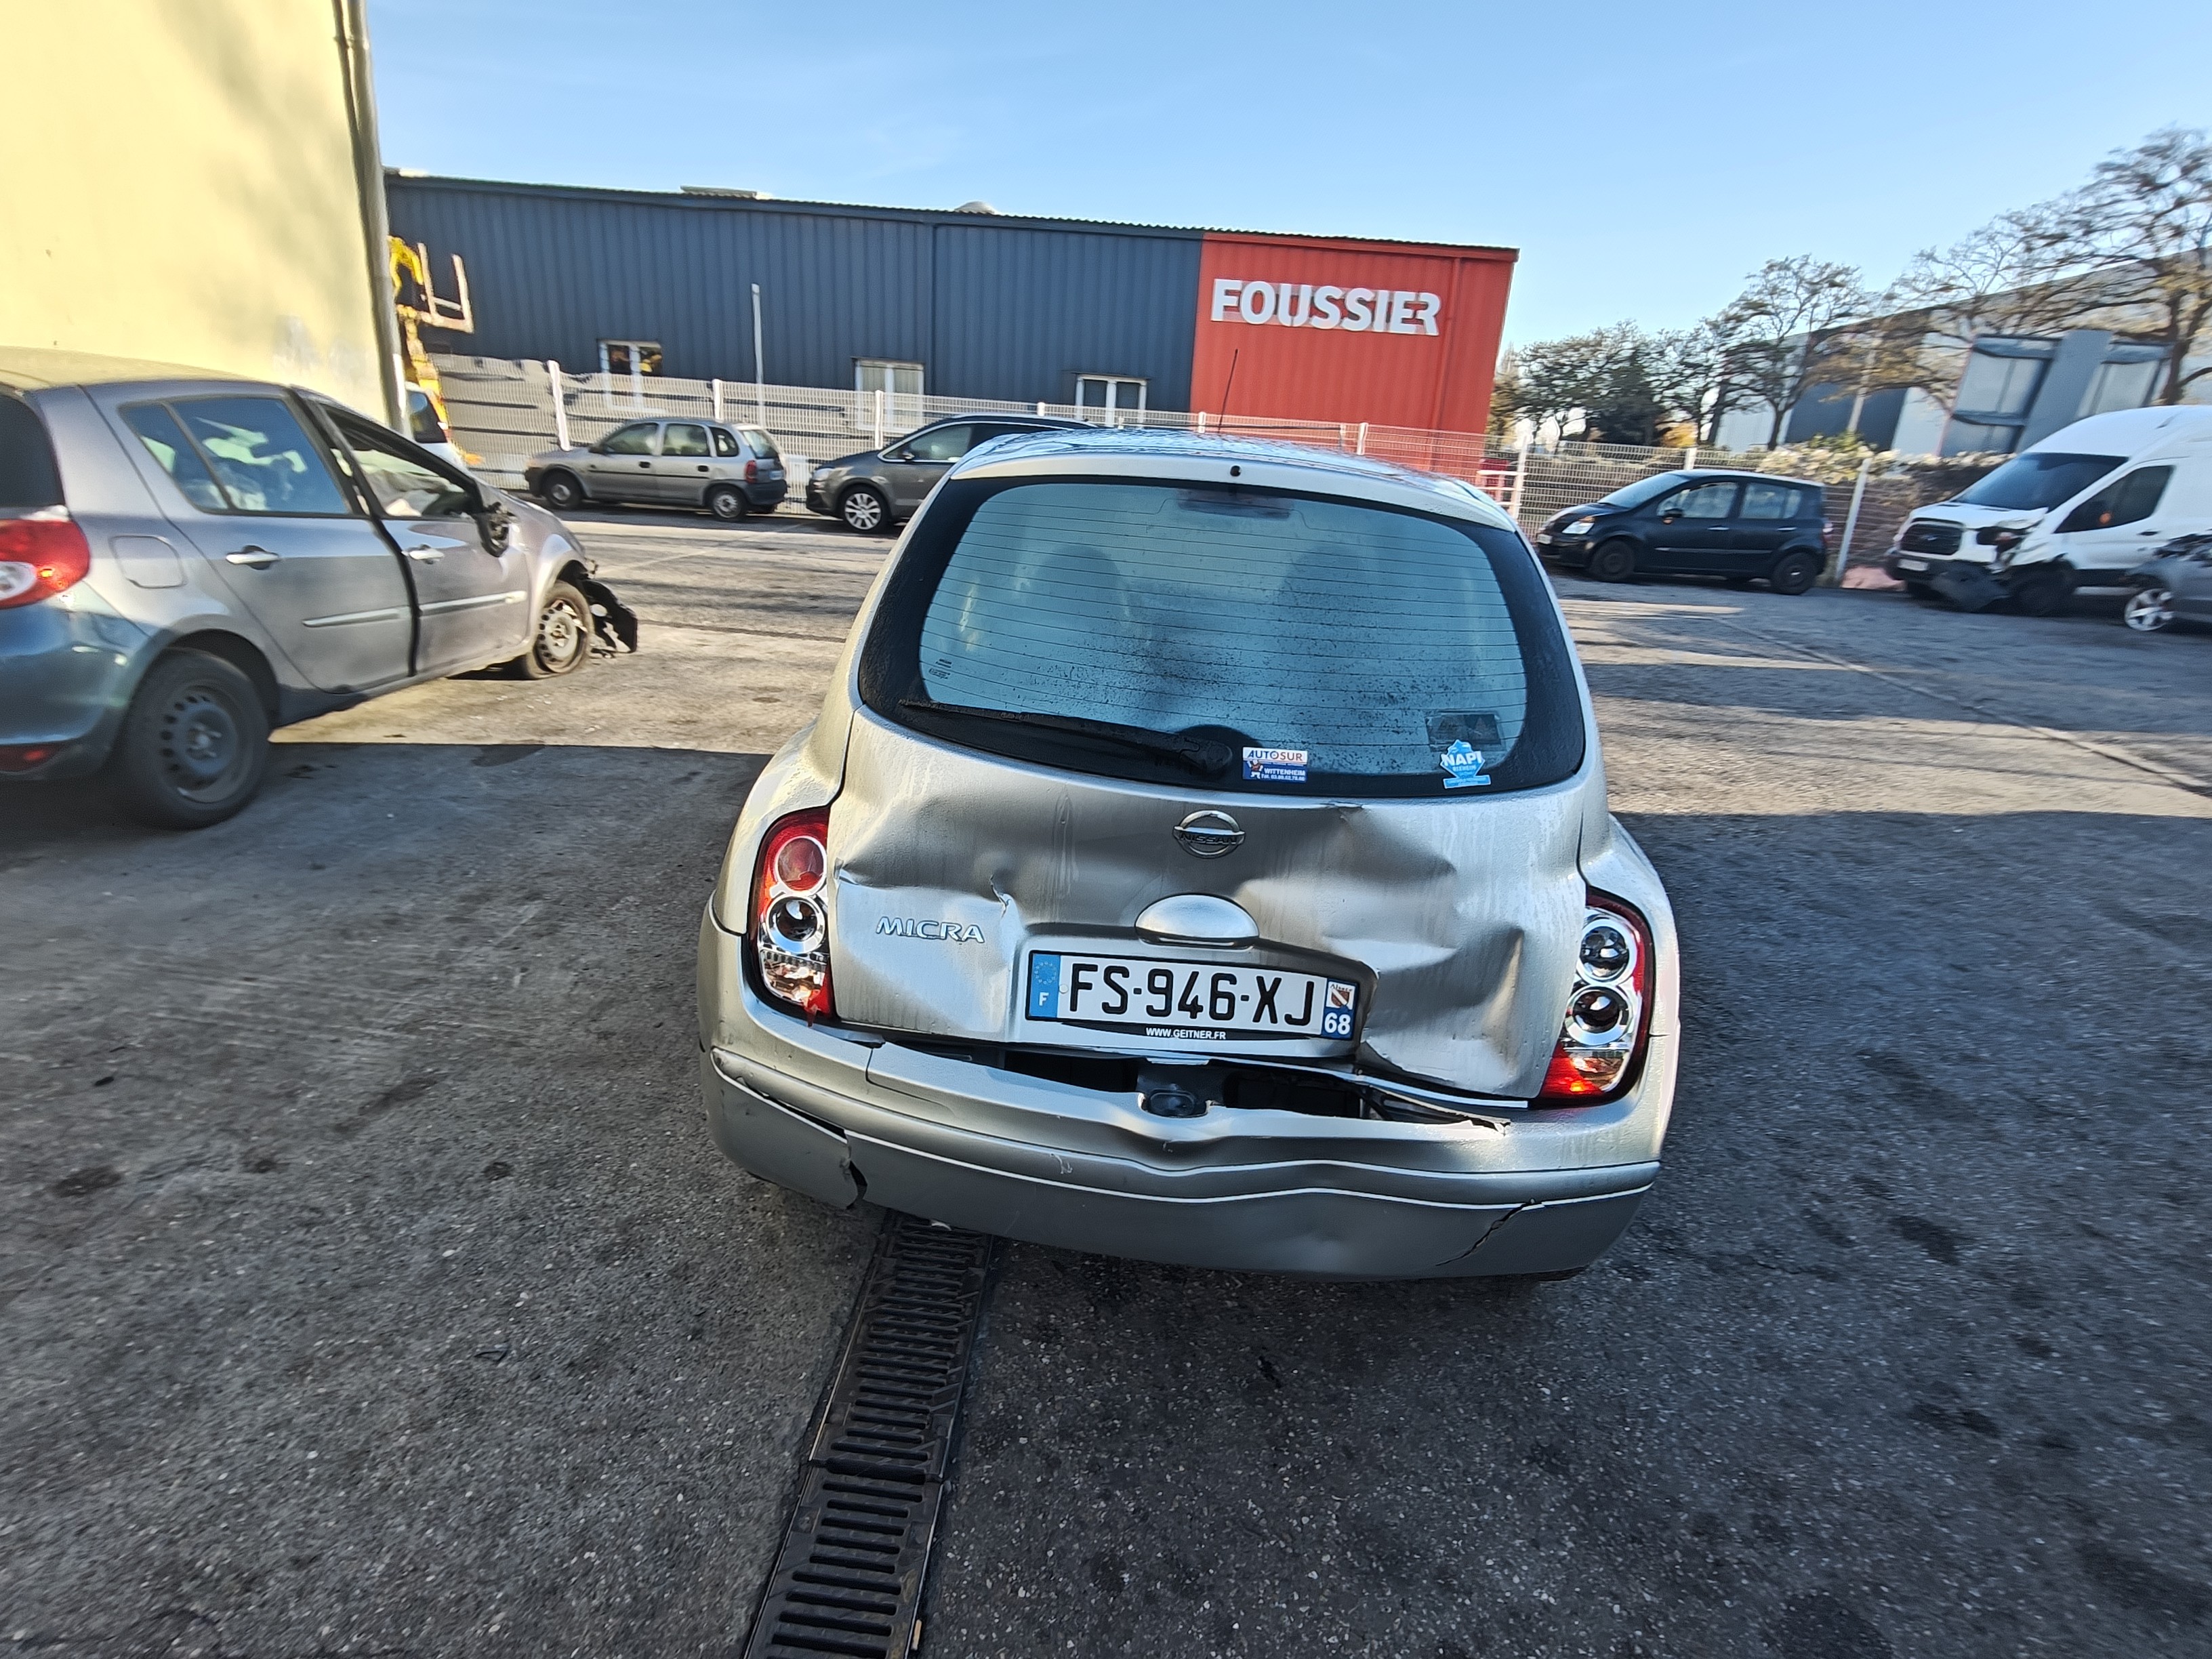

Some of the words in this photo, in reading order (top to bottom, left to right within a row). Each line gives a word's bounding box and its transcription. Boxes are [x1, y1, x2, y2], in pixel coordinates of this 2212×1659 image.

[1211, 279, 1441, 336] FOUSSIER
[1248, 750, 1303, 761] AUTOSUR
[1441, 751, 1482, 766] NAPI
[1181, 832, 1237, 846] NISSAN
[876, 916, 985, 943] MICRA
[1038, 992, 1050, 1007] F
[1069, 963, 1315, 1027] FS-946-XJ
[1324, 1012, 1351, 1036] 68
[1145, 1027, 1227, 1040] WWW.GEITNER.FR
